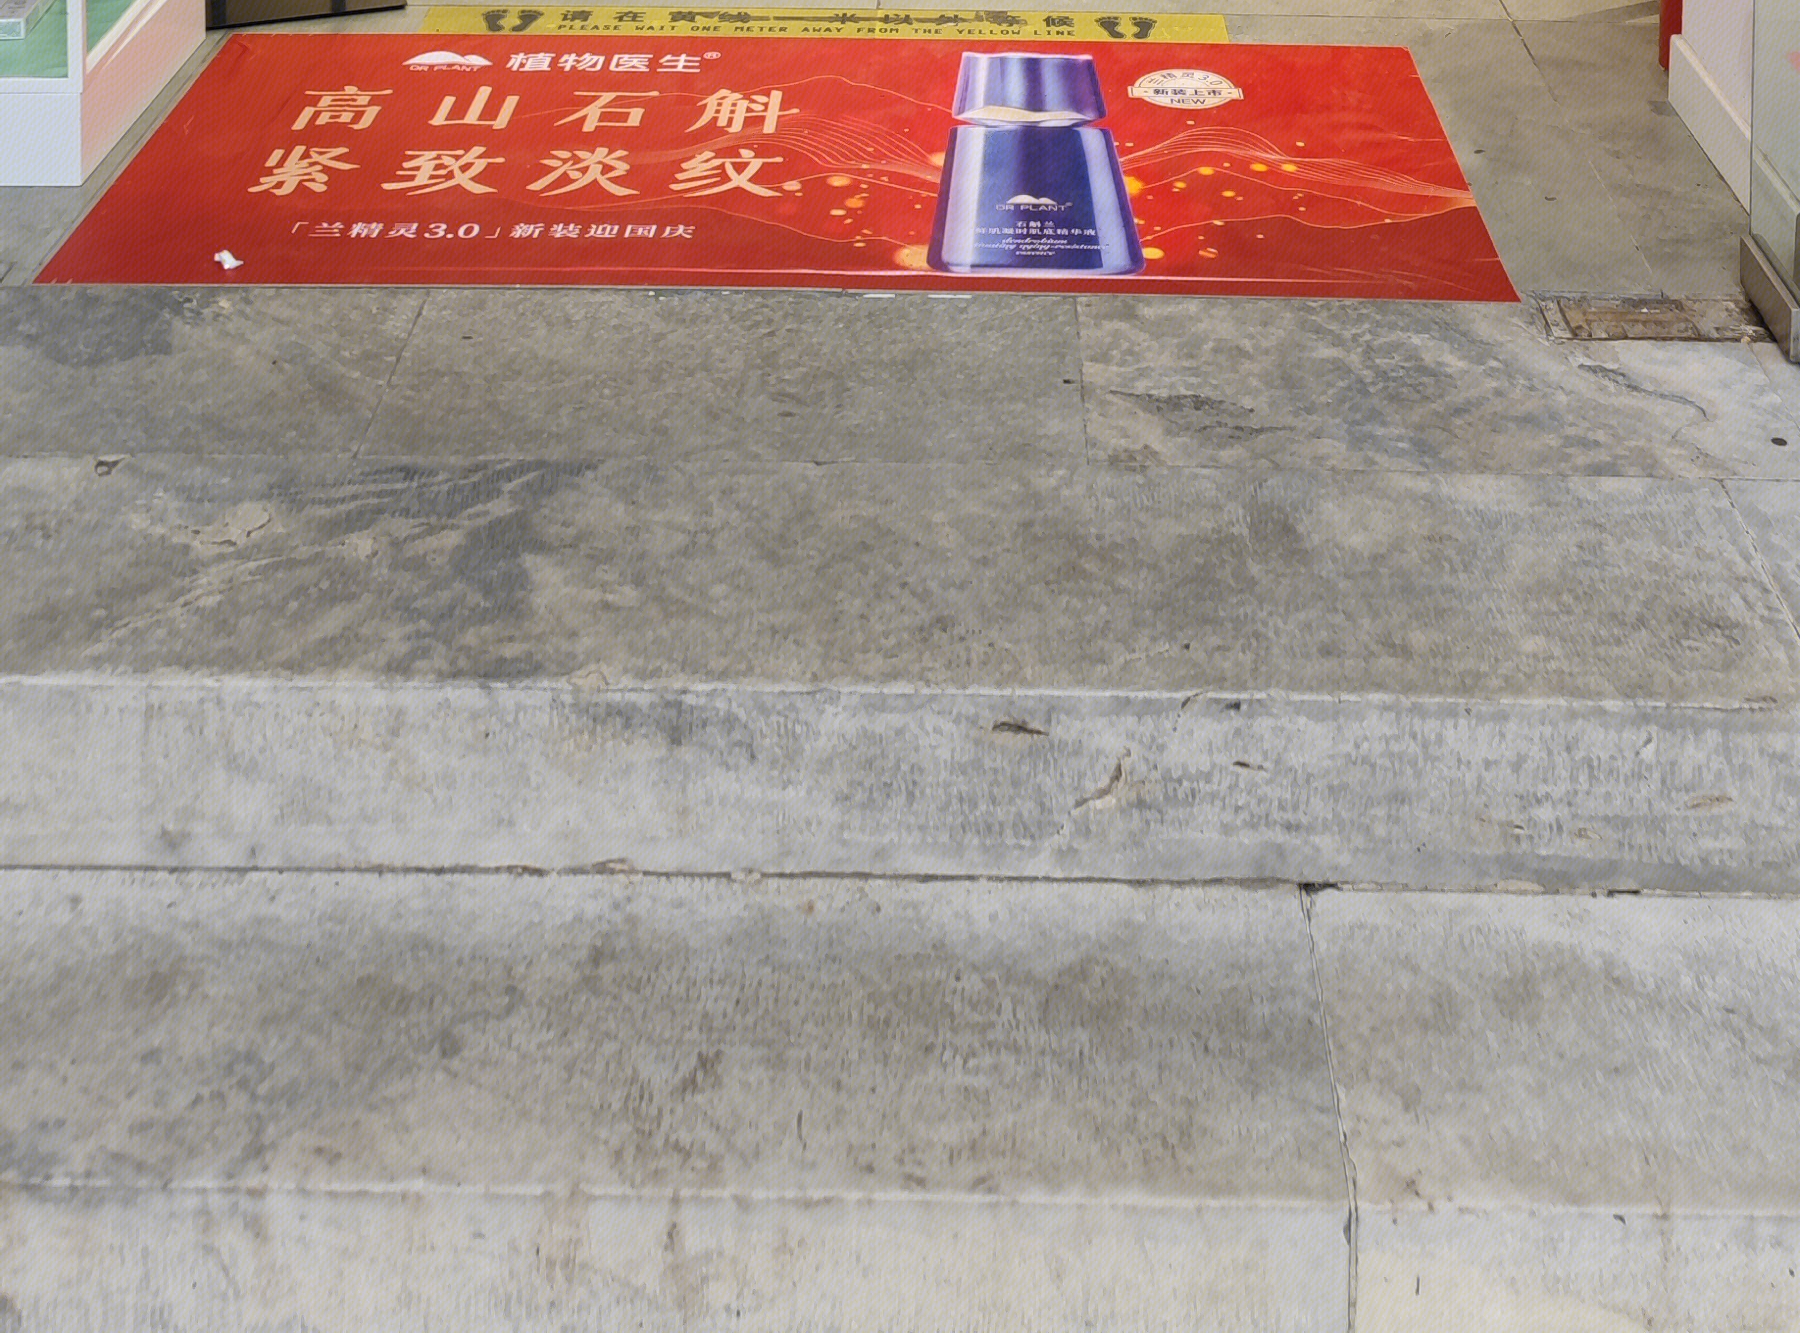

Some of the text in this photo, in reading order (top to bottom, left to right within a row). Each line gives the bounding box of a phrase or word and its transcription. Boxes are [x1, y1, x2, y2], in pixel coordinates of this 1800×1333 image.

[506, 53, 702, 74] 植物医生
[1153, 88, 1223, 96] 新装上市
[291, 85, 801, 133] 高山石斛
[248, 145, 785, 198] 紧致淡纹
[1020, 204, 1067, 212] PLANT
[291, 221, 696, 240] 「兰精灵3.0」新装迎国庆
